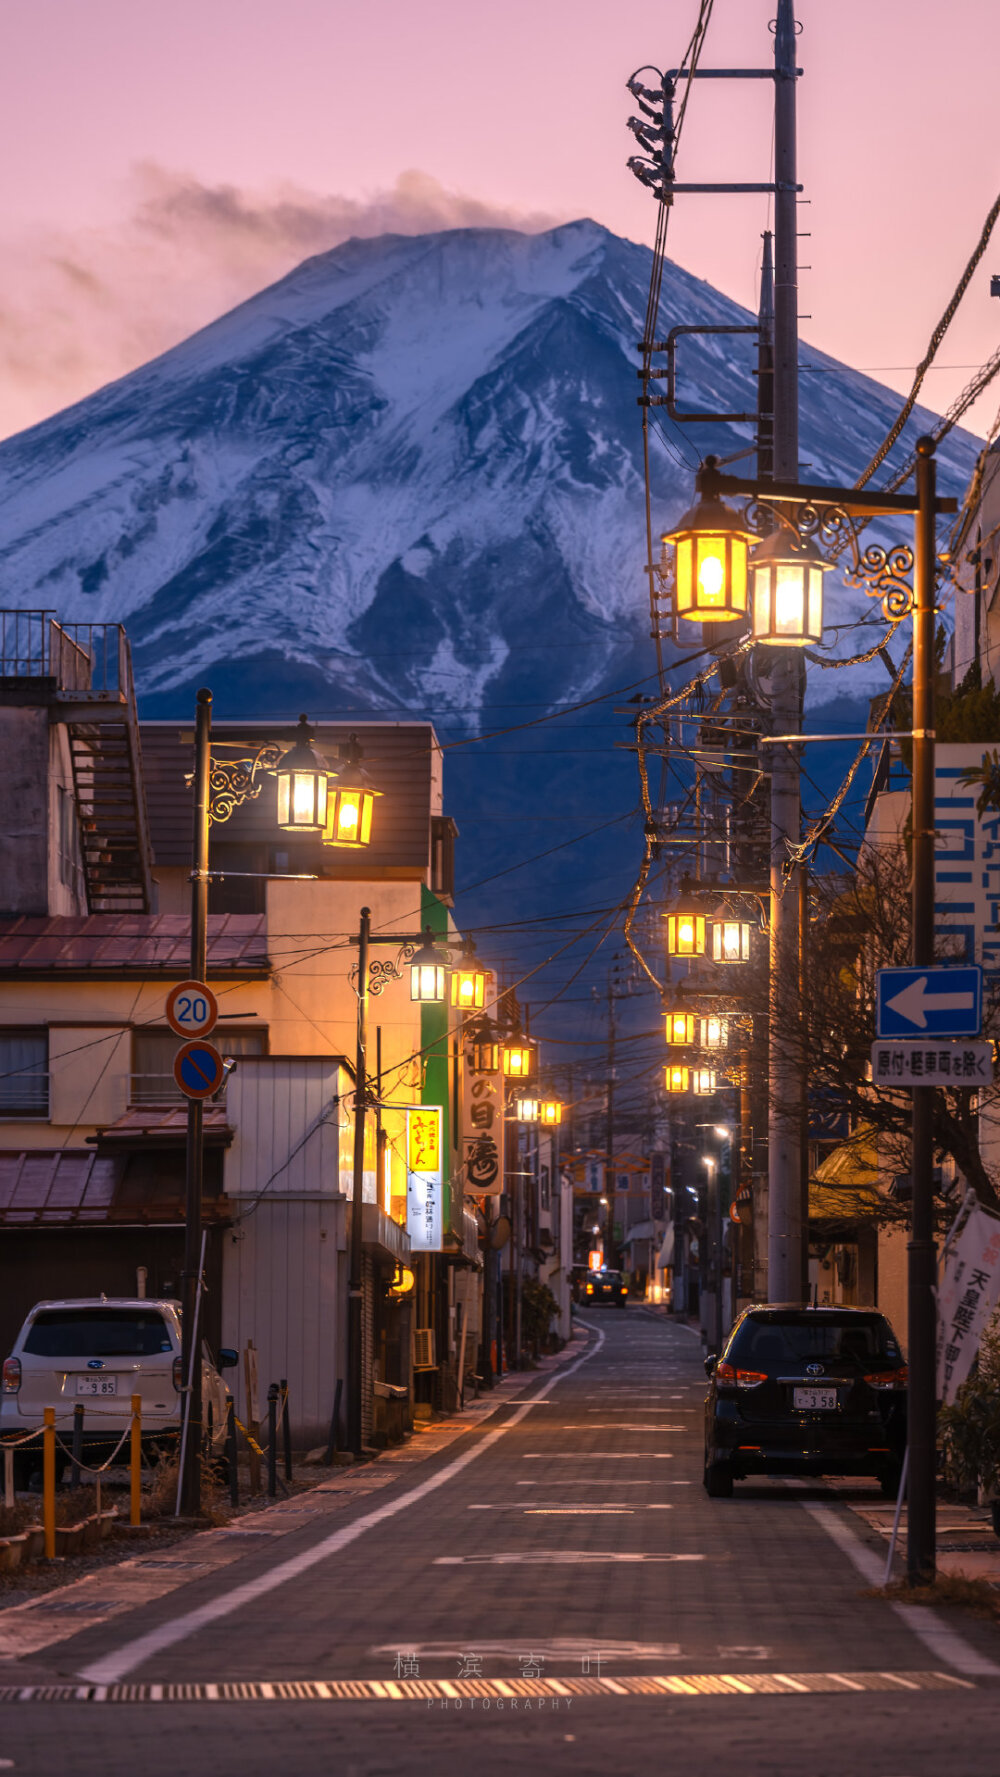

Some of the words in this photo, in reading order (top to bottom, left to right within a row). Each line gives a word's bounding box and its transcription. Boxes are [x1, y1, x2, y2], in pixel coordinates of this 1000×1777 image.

[178, 997, 206, 1022] 20
[878, 1050, 986, 1077] 原付・軽車両を除く
